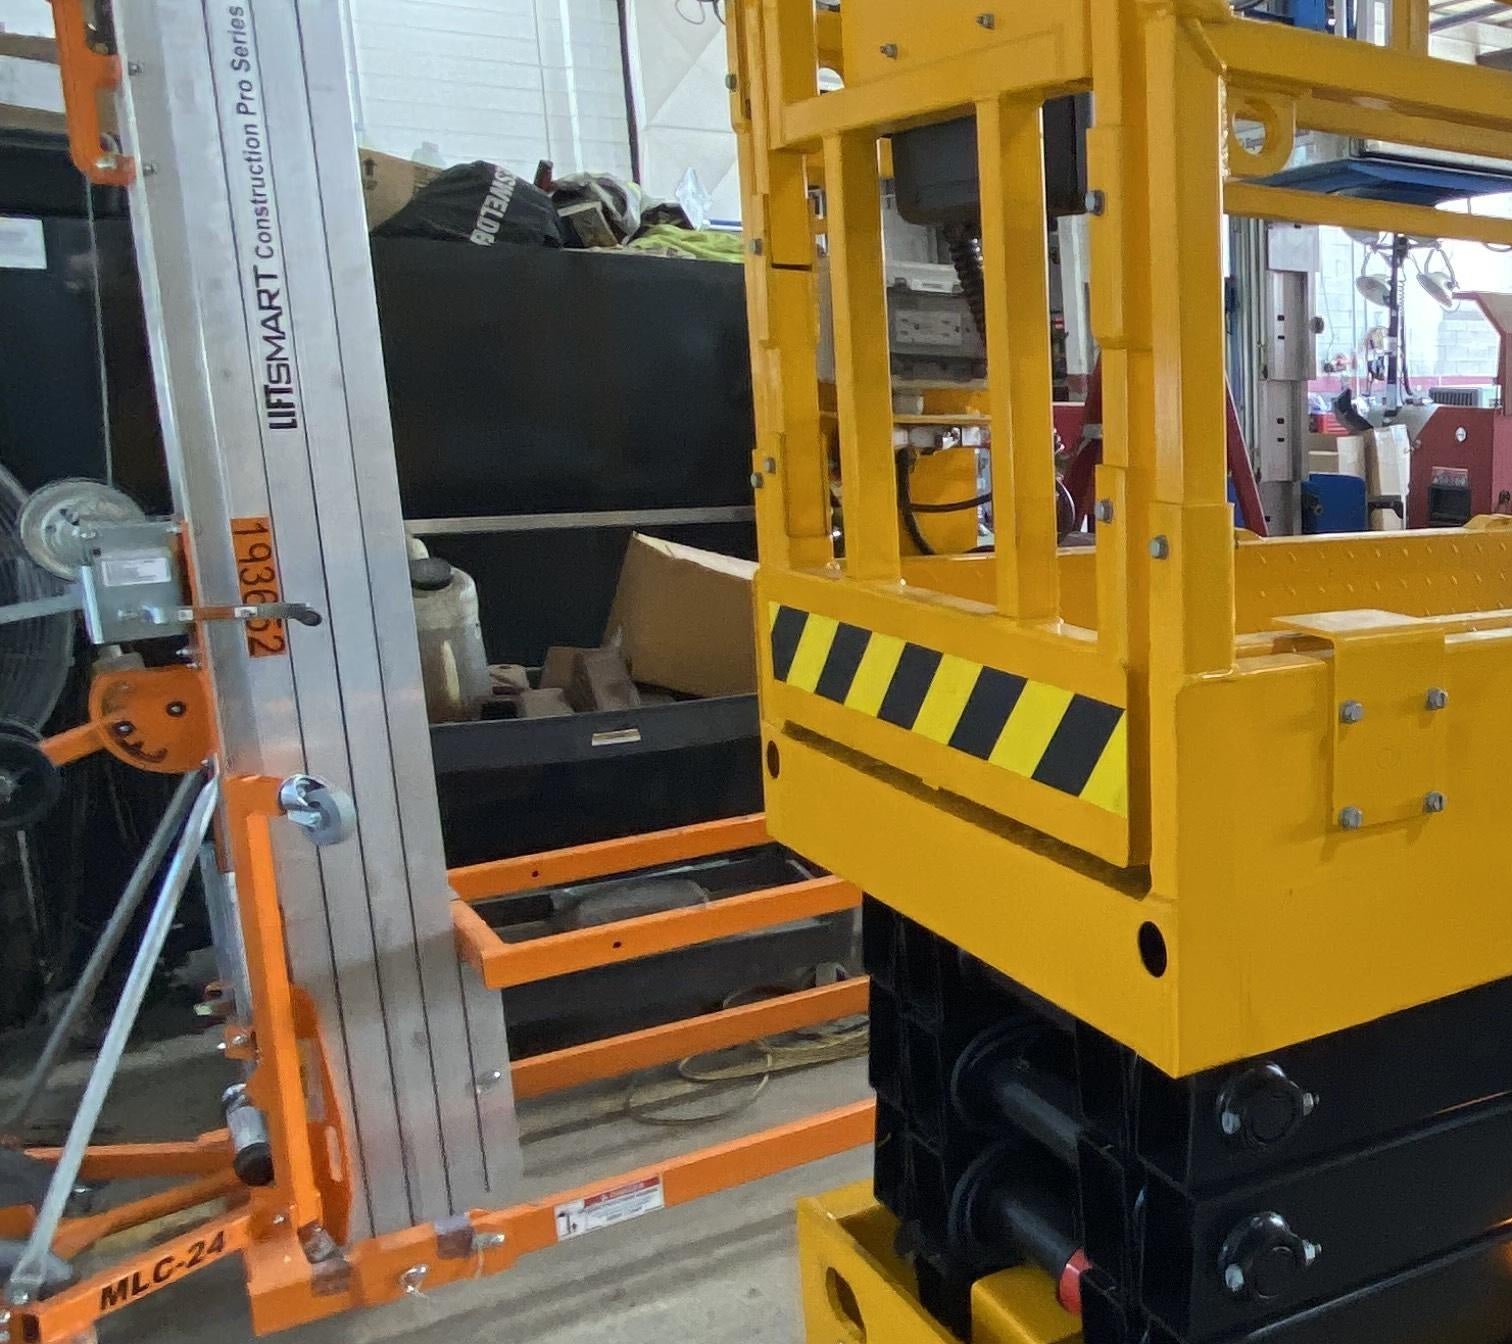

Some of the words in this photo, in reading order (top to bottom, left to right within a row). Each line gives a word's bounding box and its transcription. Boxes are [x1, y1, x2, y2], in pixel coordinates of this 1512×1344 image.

[229, 5, 251, 72] Series
[236, 79, 257, 116] Pro
[242, 124, 275, 259] Construction
[253, 264, 298, 429] LIFTSMART
[101, 1230, 225, 1311] MLC-24
